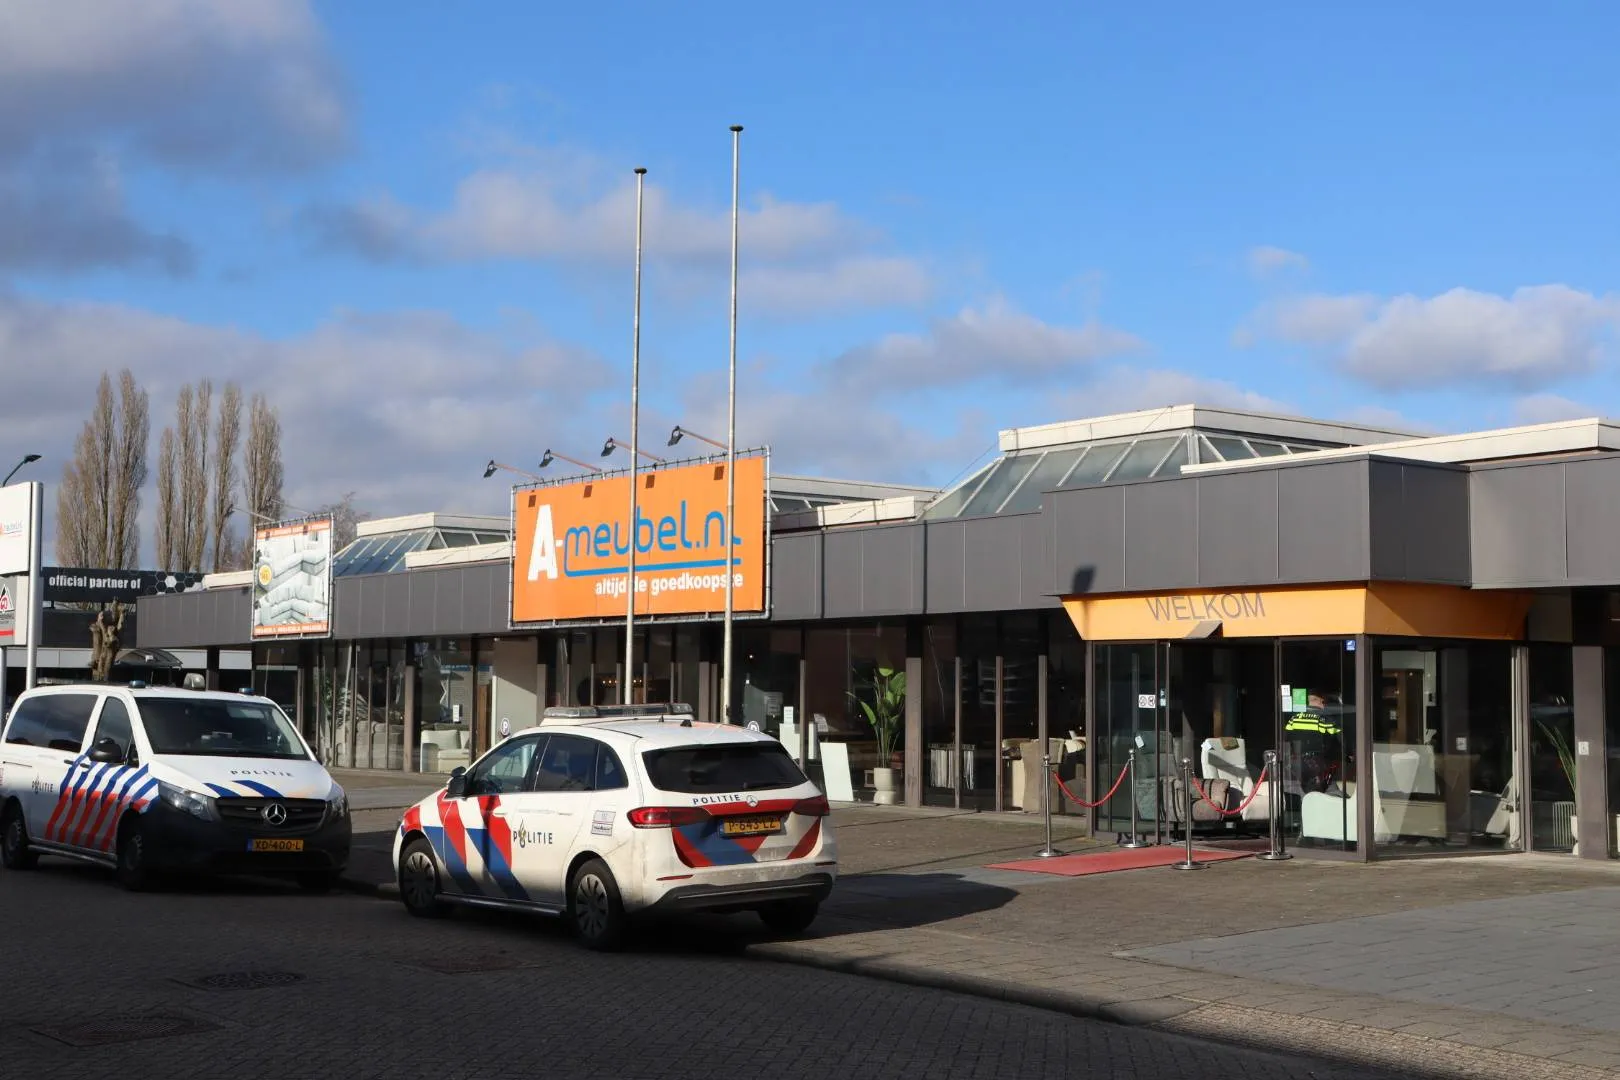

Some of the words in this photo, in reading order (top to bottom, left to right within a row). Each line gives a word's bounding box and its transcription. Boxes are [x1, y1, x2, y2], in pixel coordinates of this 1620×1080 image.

[49, 575, 87, 587] official
[89, 577, 128, 589] partner
[130, 578, 141, 589] of
[595, 577, 627, 598] altijd
[1145, 592, 1267, 621] WELKOM
[230, 769, 294, 779] POLITIE
[693, 794, 741, 805] POLITIE
[513, 825, 553, 848] POLITIE
[255, 840, 301, 850] XD-400-L
